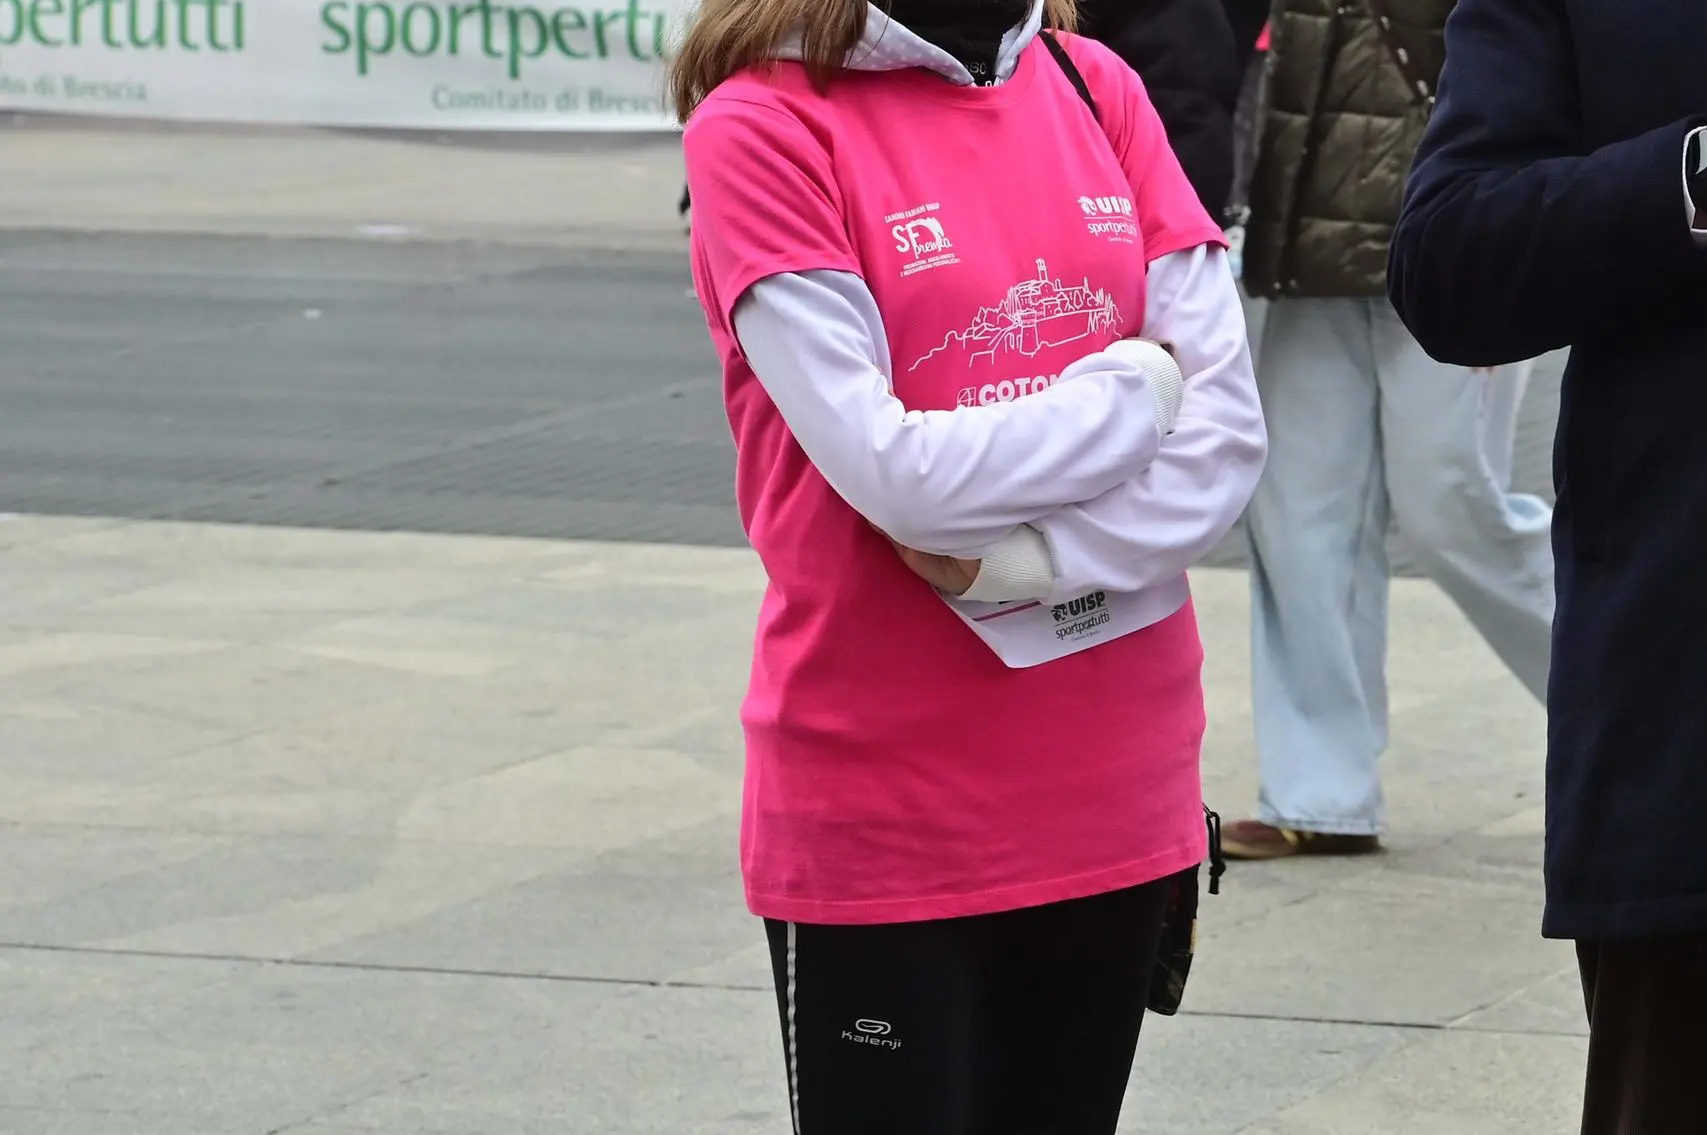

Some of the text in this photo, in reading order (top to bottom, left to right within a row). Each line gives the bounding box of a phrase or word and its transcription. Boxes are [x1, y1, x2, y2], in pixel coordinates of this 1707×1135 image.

[431, 83, 547, 112] Comitato
[555, 87, 580, 112] di
[1095, 196, 1132, 215] UIP
[1068, 591, 1105, 616] UISP
[1055, 610, 1110, 641] sportpertutti
[841, 1030, 902, 1050] Kalenji
